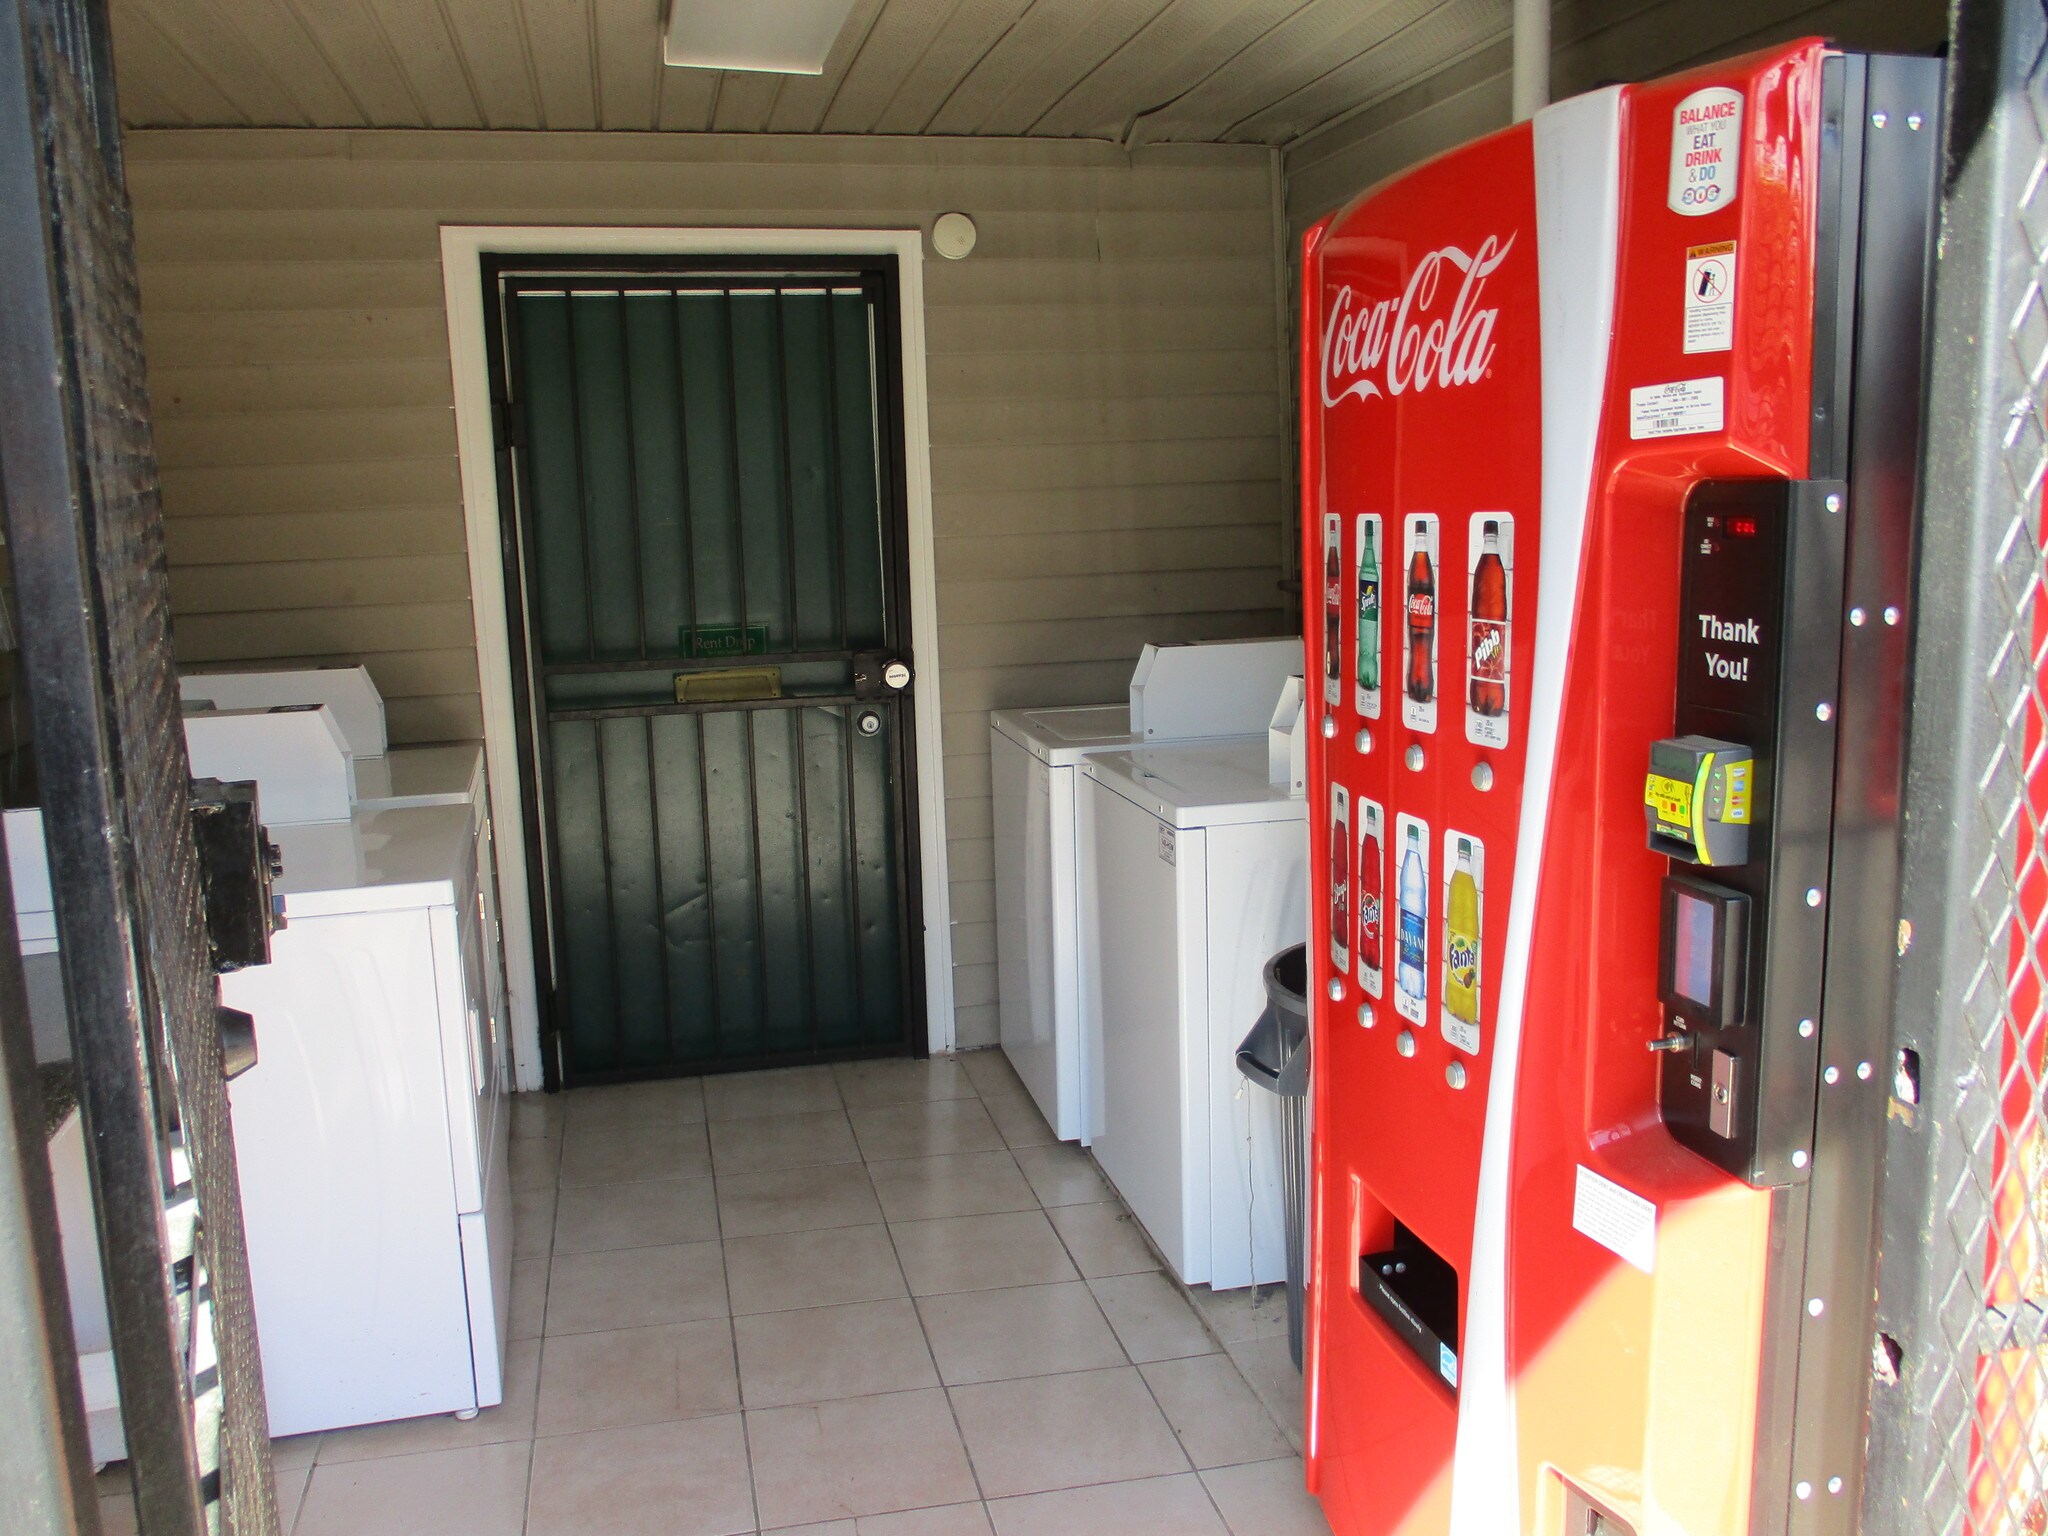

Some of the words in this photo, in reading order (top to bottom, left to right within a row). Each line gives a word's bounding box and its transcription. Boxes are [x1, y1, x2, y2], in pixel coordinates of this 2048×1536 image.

[1680, 101, 1736, 125] BALANCE
[1687, 121, 1708, 135] WHAT
[1710, 119, 1727, 132] YOU
[1693, 133, 1716, 150] EAT
[1685, 149, 1722, 168] DRINK
[1689, 168, 1697, 183] &
[1700, 165, 1716, 181] DO
[1321, 229, 1518, 408] Coca-Cola
[1409, 593, 1434, 615] Coca-Cola
[1699, 614, 1760, 645] Thank
[695, 636, 722, 650] Rent
[1475, 629, 1500, 671] Pibb
[1705, 651, 1749, 682] You!
[1450, 942, 1475, 971] Fanta
